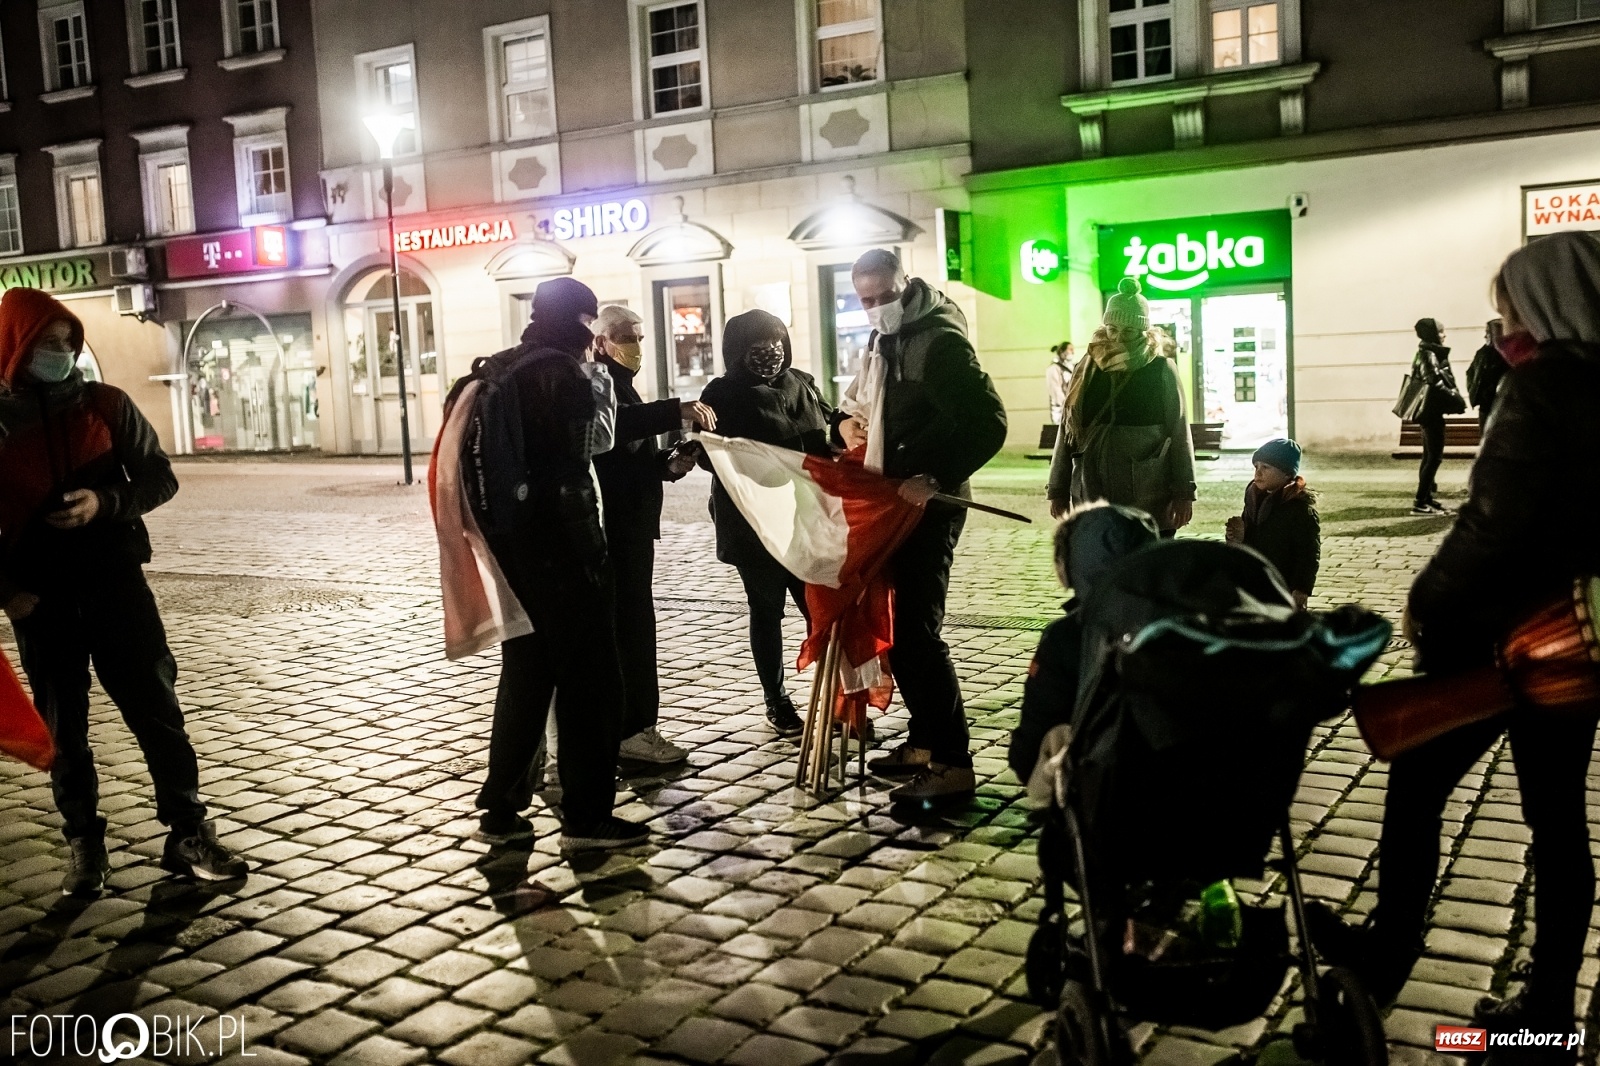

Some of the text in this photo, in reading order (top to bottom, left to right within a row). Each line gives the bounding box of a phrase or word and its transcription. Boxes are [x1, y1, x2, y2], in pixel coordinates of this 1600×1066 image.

[553, 199, 649, 240] SHIRO
[1534, 193, 1600, 210] LOKA
[1123, 231, 1265, 277] żabka
